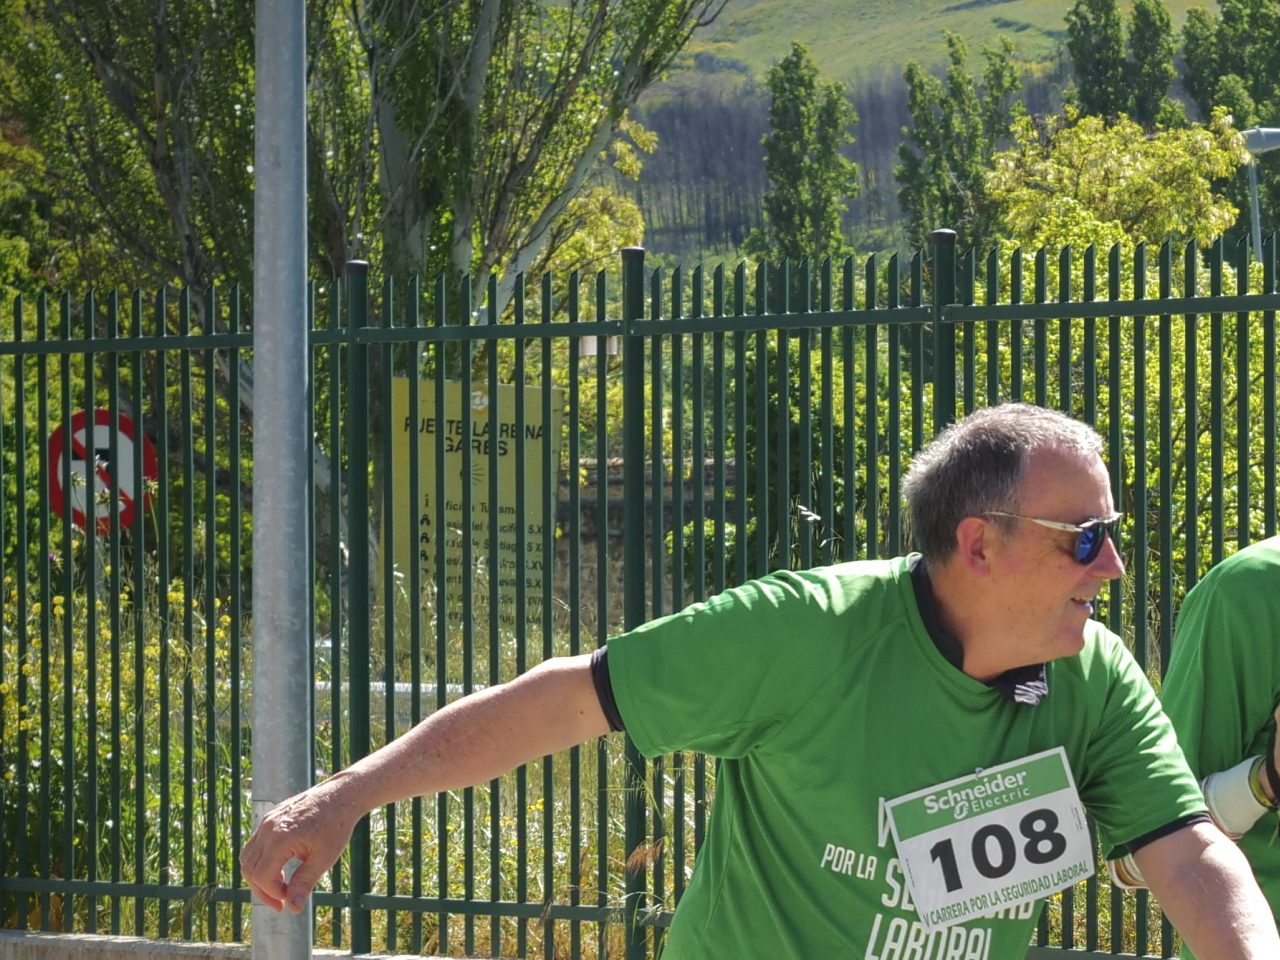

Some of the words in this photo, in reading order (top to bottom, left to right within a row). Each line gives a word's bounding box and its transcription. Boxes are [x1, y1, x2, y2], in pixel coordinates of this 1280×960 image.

[501, 423, 543, 440] RENA
[924, 769, 1027, 814] Schneider
[972, 787, 1030, 812] Electric
[820, 843, 856, 876] POR
[856, 853, 878, 881] LA
[929, 808, 1067, 893] 108
[922, 913, 930, 928] V
[930, 901, 969, 926] CARRERA
[969, 895, 988, 911] POR
[988, 890, 1001, 906] LA
[1001, 875, 1050, 902] SEGURIDAD
[1050, 860, 1088, 887] LABORAL
